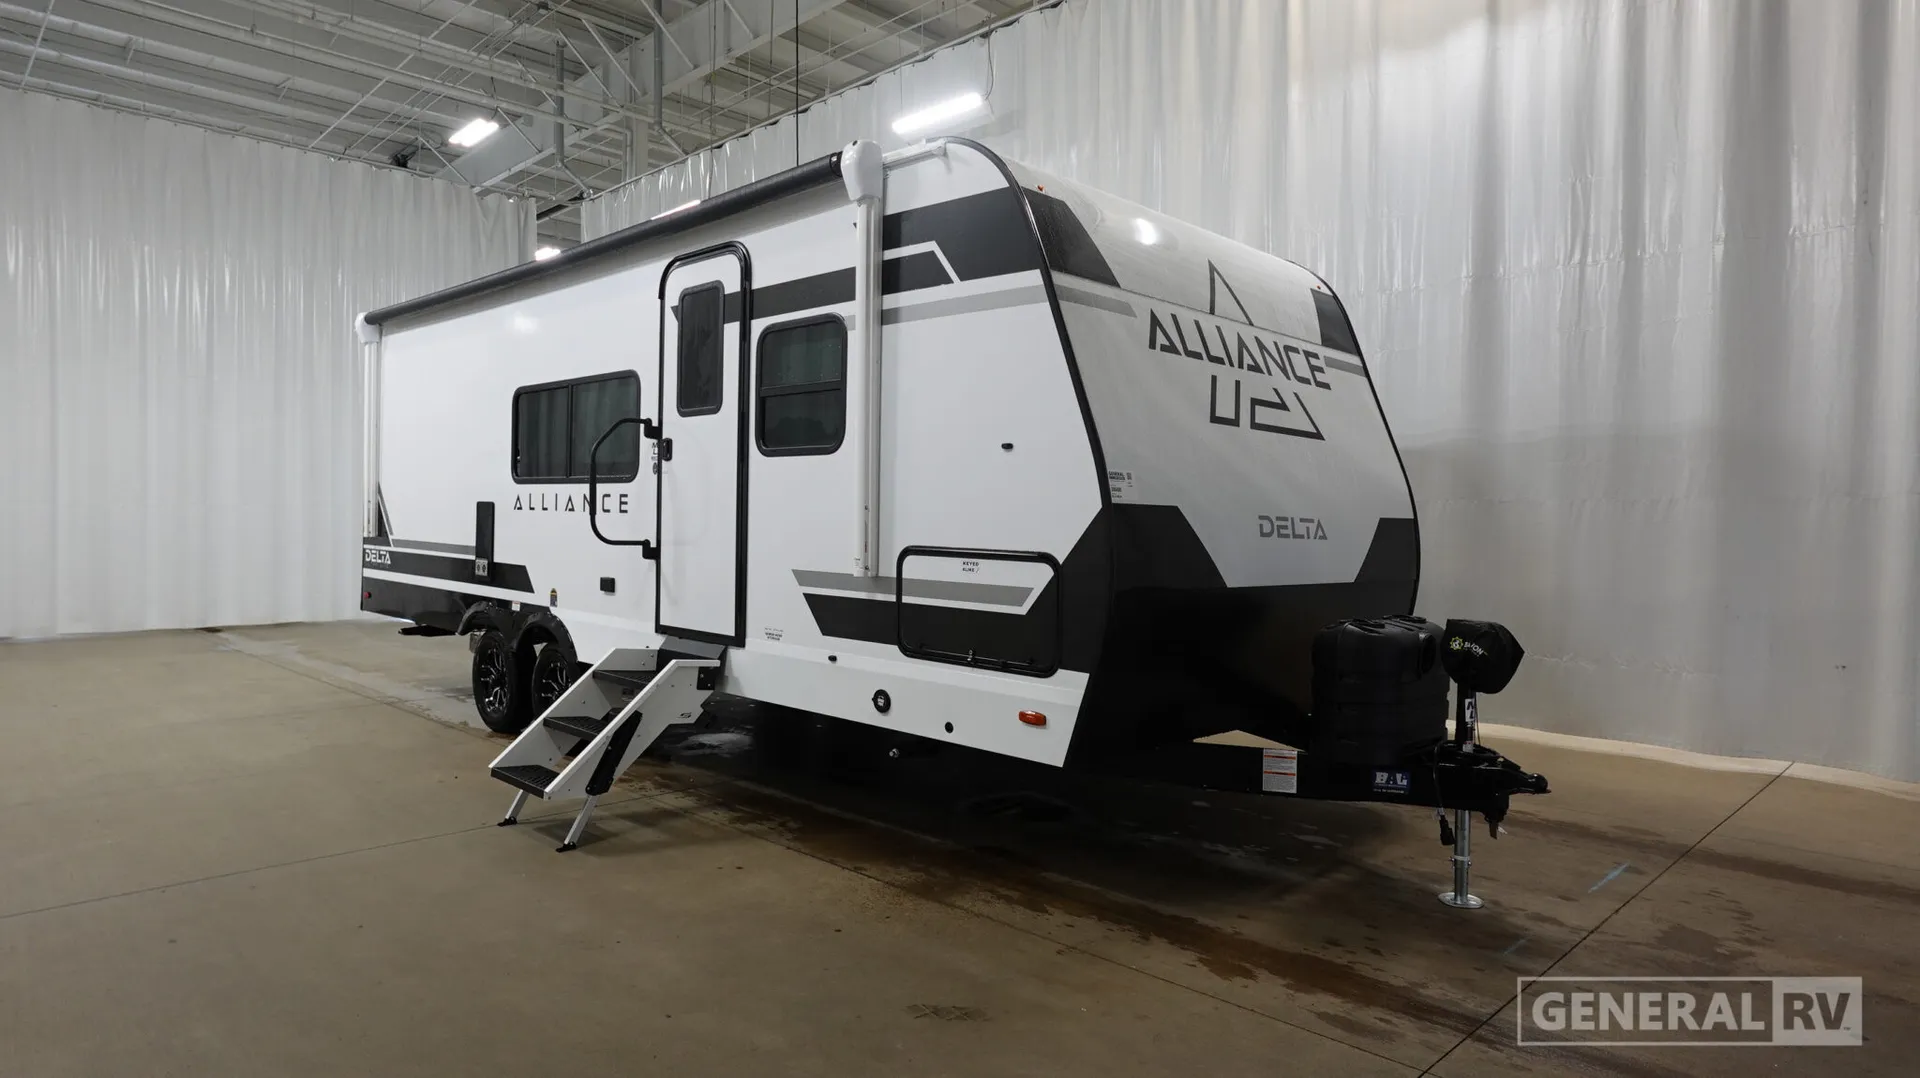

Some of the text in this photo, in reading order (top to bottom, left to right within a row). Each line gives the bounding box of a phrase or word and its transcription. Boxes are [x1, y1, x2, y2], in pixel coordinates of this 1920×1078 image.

[1148, 308, 1331, 390] ALLIANCE
[513, 493, 628, 514] ALLIANCE
[1258, 515, 1328, 540] DELTA
[365, 549, 391, 565] DELTA
